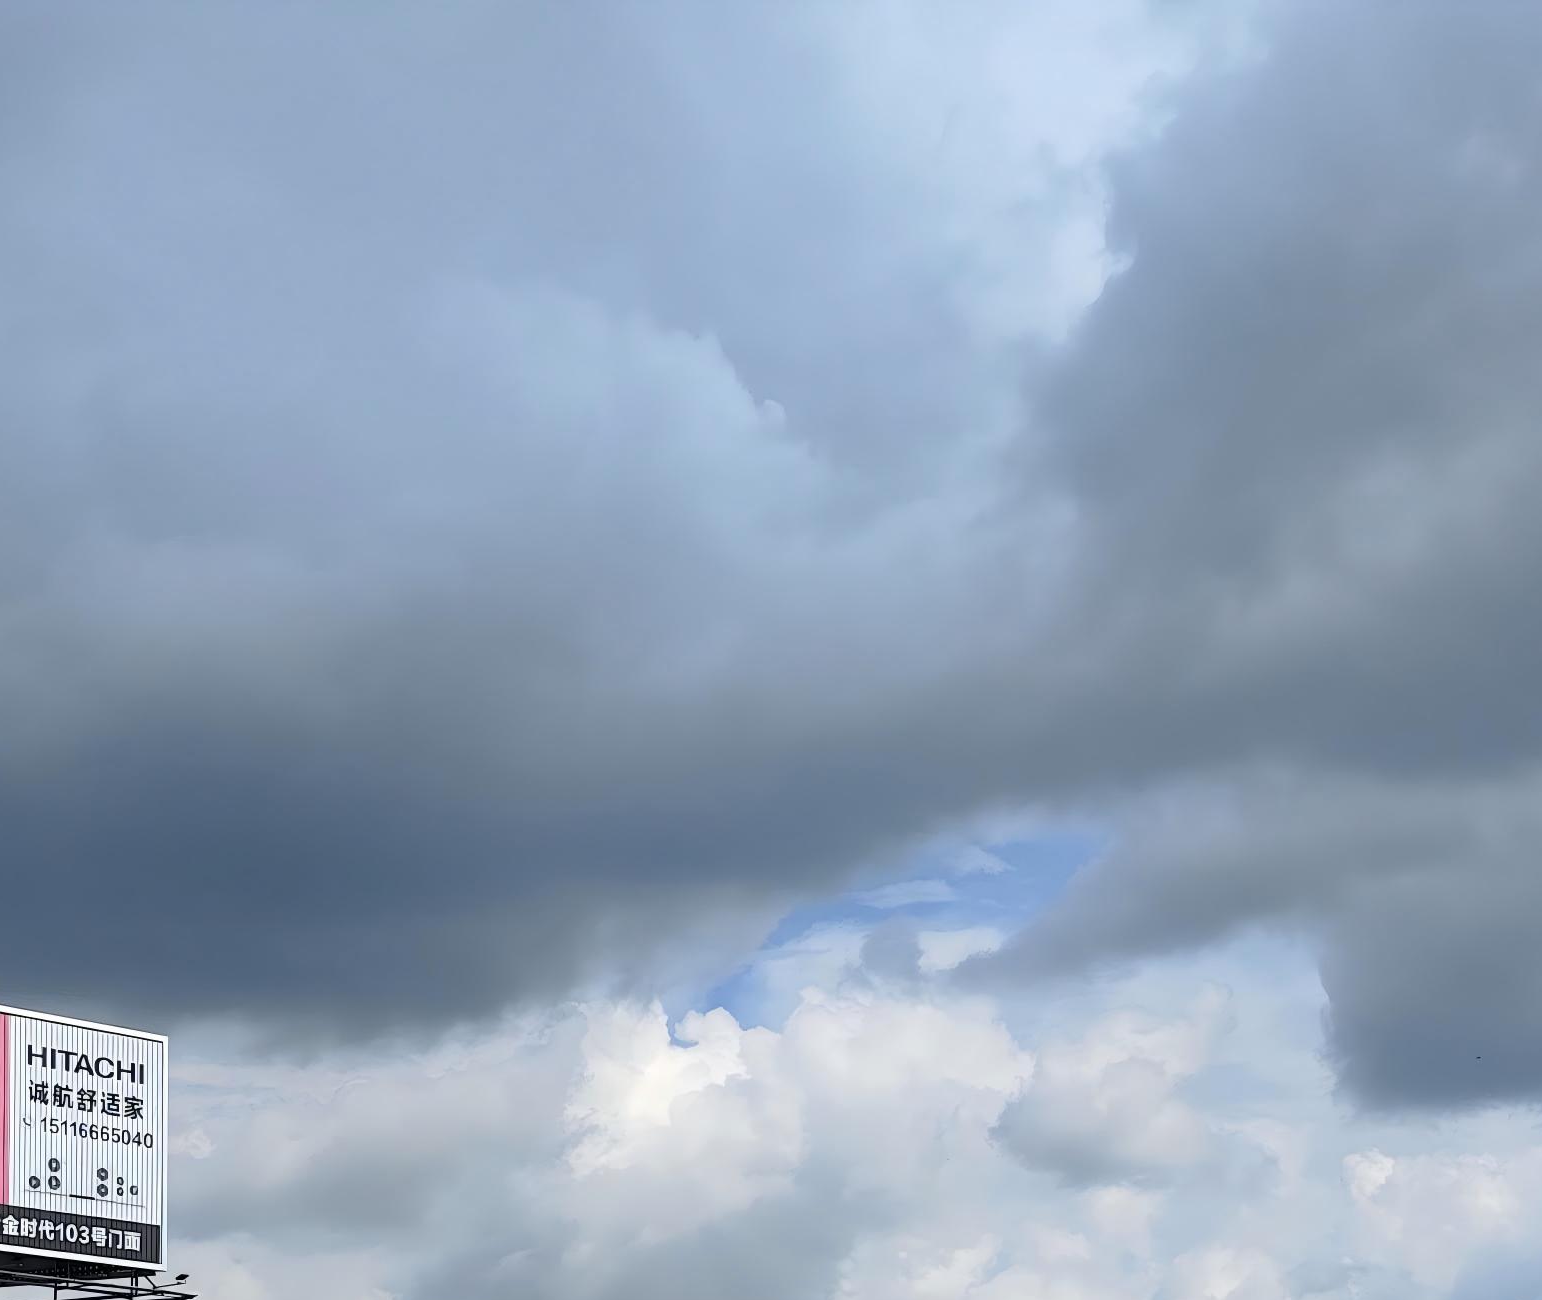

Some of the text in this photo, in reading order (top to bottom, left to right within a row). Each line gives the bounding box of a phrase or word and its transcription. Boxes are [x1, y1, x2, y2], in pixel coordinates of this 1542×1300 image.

[27, 1044, 144, 1085] HITACHI
[28, 1079, 144, 1120] 诚航舒适家
[40, 1116, 154, 1149] 15116665040
